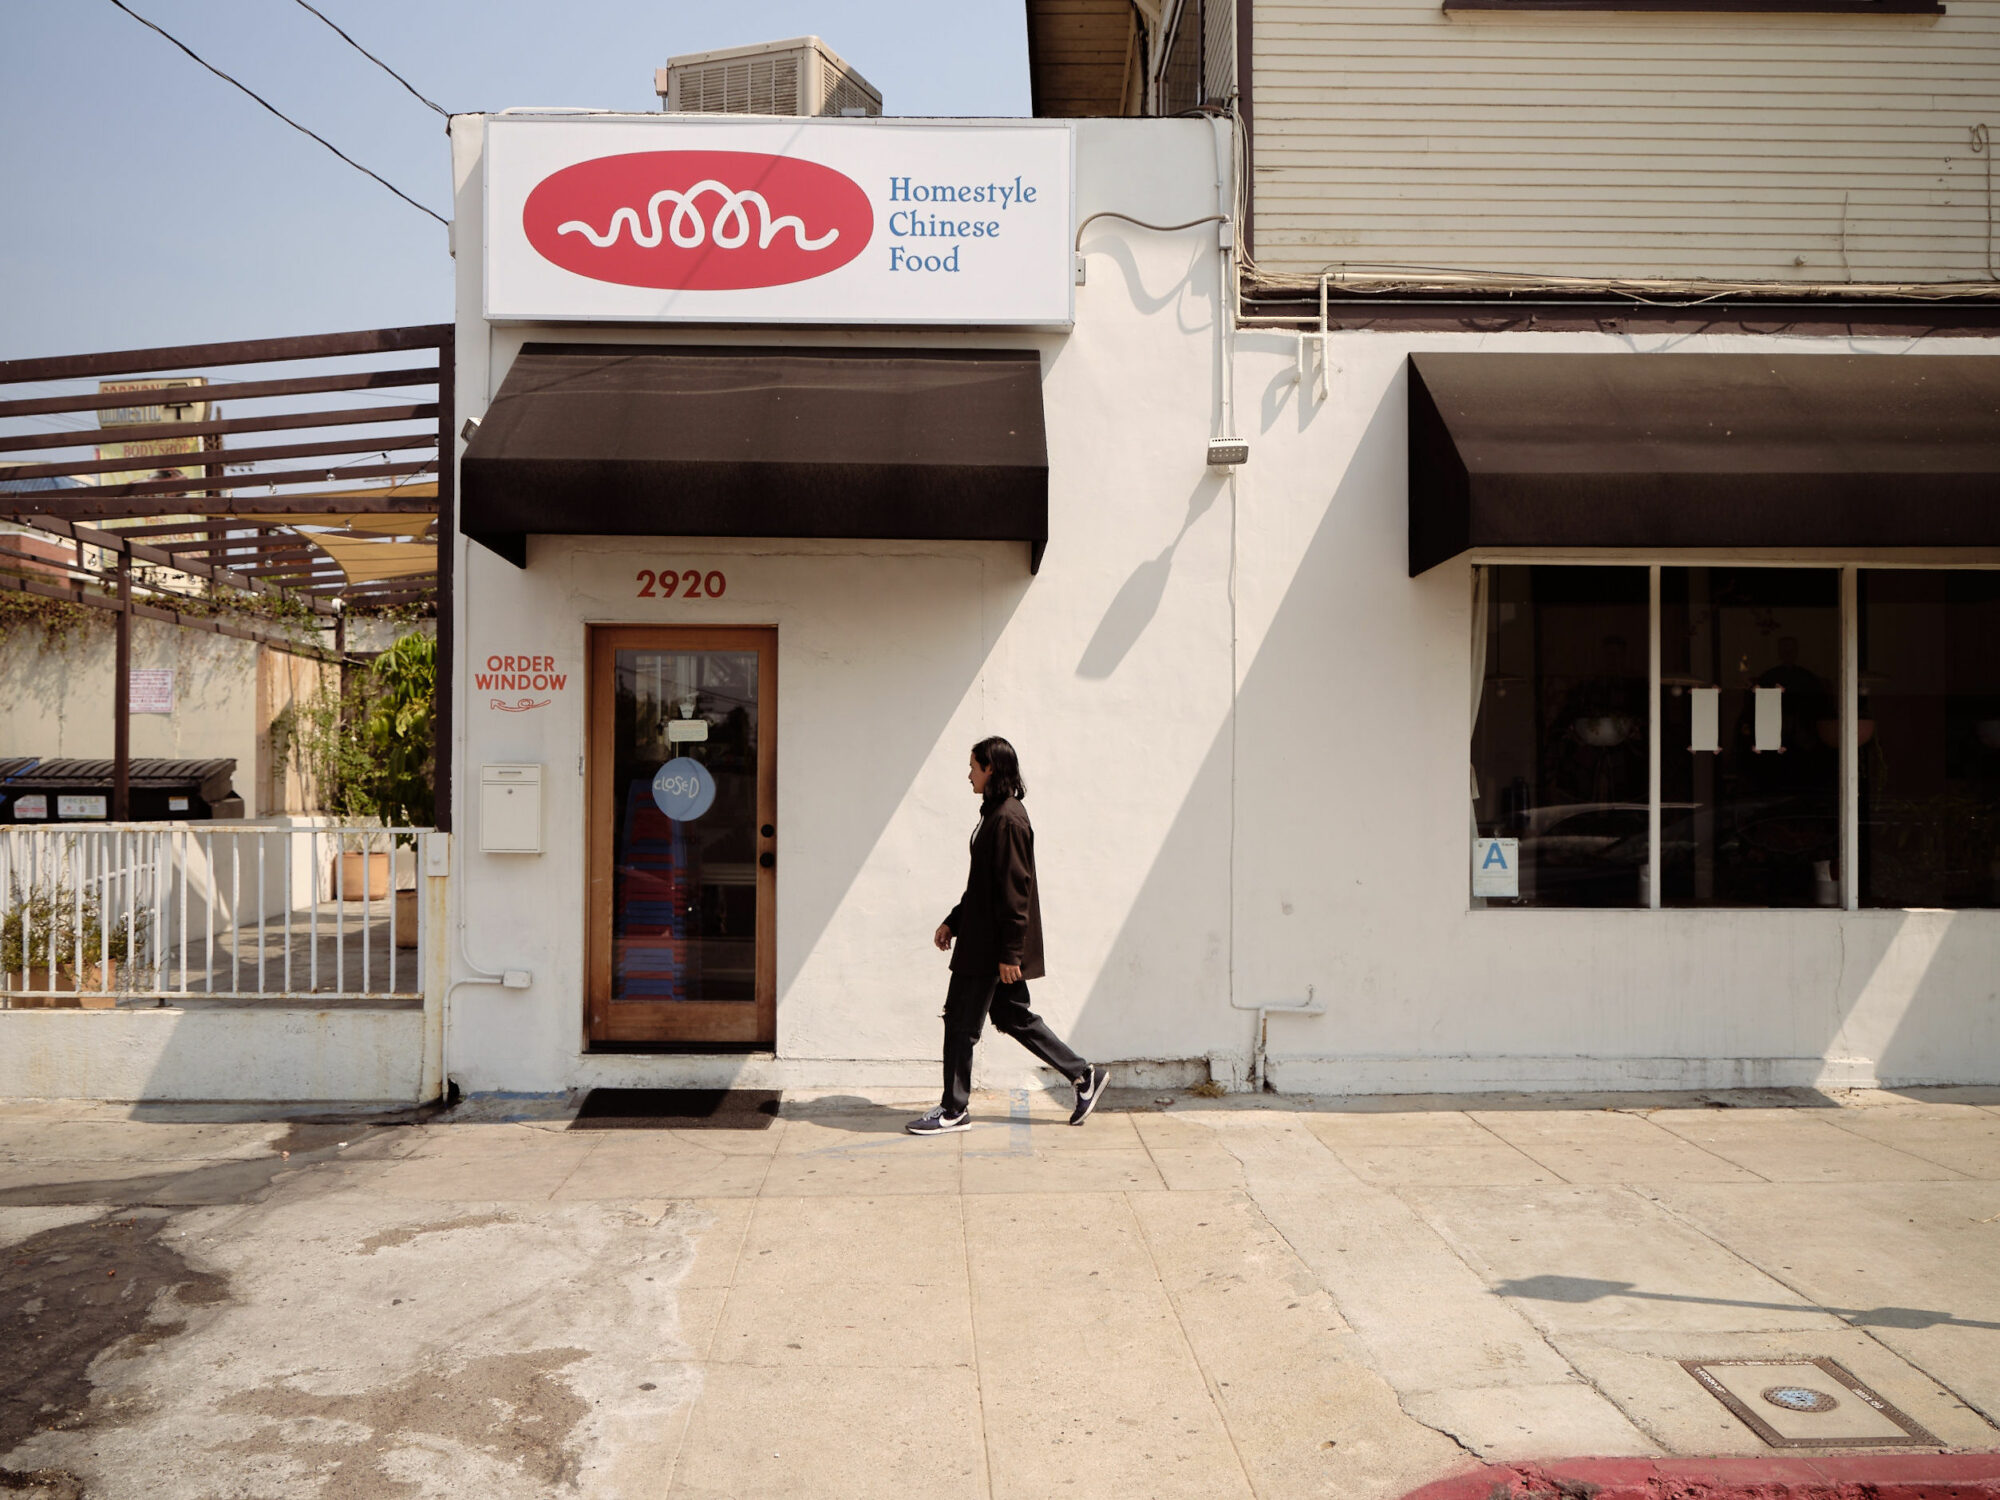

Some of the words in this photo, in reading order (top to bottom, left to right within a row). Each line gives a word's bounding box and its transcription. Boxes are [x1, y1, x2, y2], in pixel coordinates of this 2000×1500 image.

[889, 175, 1037, 210] Homestyle
[889, 209, 1000, 237] Chinese
[889, 245, 960, 272] Food
[636, 569, 727, 598] 2920
[486, 655, 555, 672] ORDER
[474, 673, 568, 691] WINDOW
[1482, 842, 1508, 870] A
